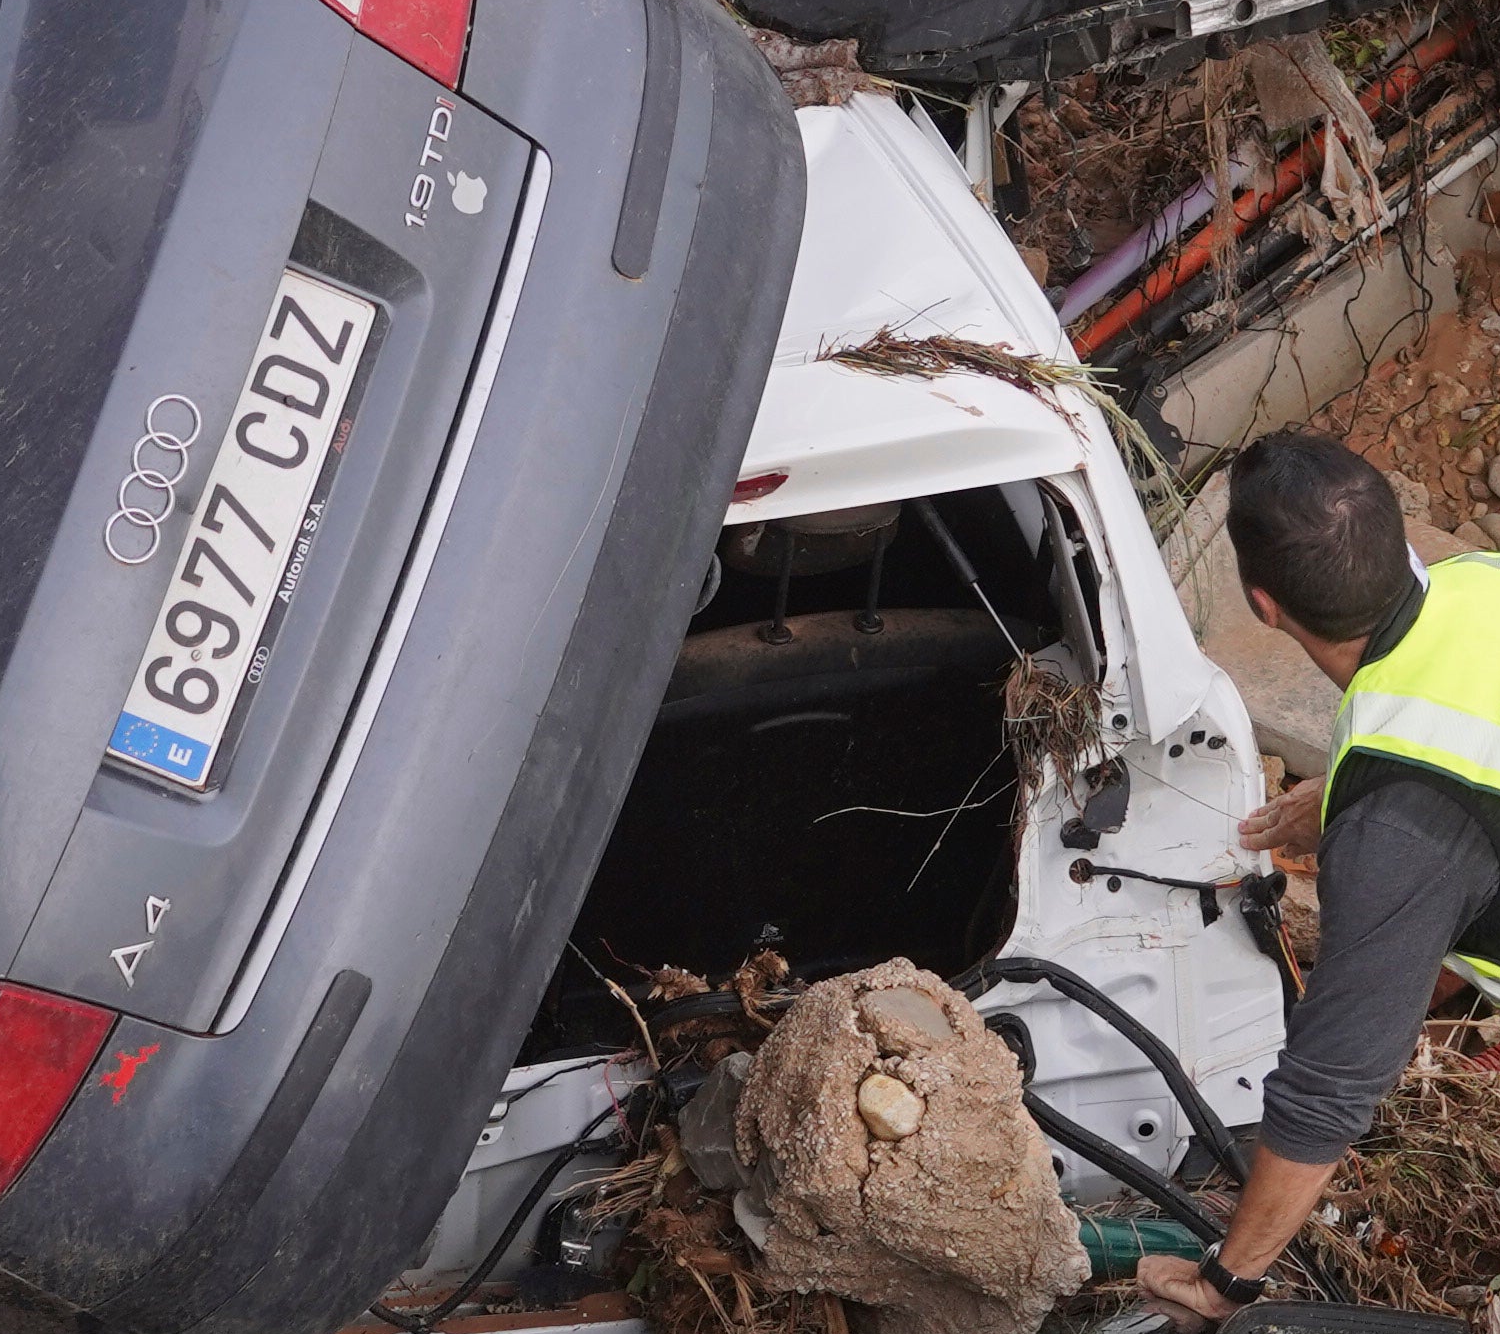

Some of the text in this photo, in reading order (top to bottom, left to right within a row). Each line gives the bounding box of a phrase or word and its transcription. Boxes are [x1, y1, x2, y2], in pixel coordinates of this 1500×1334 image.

[404, 95, 456, 228] 1.9 TDI
[332, 418, 352, 454] Audi
[144, 483, 276, 716] 6977
[235, 295, 355, 470] CDZ
[109, 895, 172, 988] A4
